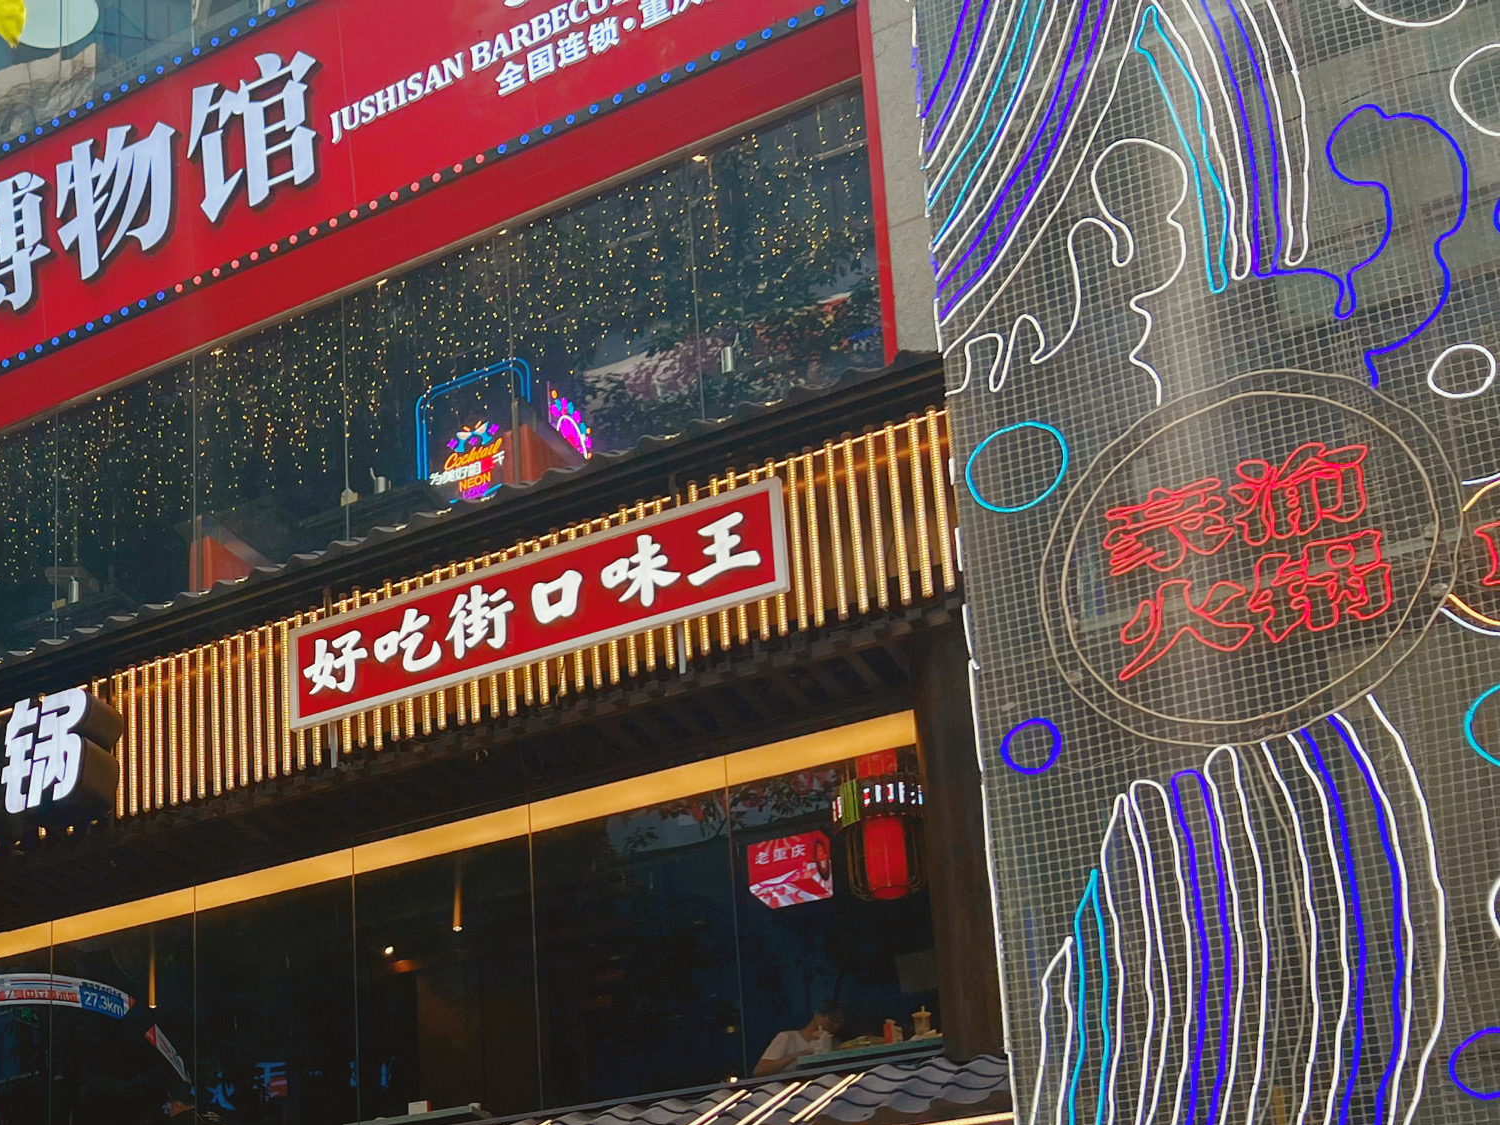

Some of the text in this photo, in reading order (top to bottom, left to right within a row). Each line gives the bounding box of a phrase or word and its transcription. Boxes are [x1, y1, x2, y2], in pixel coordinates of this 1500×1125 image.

[330, 51, 466, 145] JUSHISAN
[459, 471, 492, 493] NEON
[301, 511, 762, 696] 好吃街口味王
[754, 842, 807, 866] 老重庆
